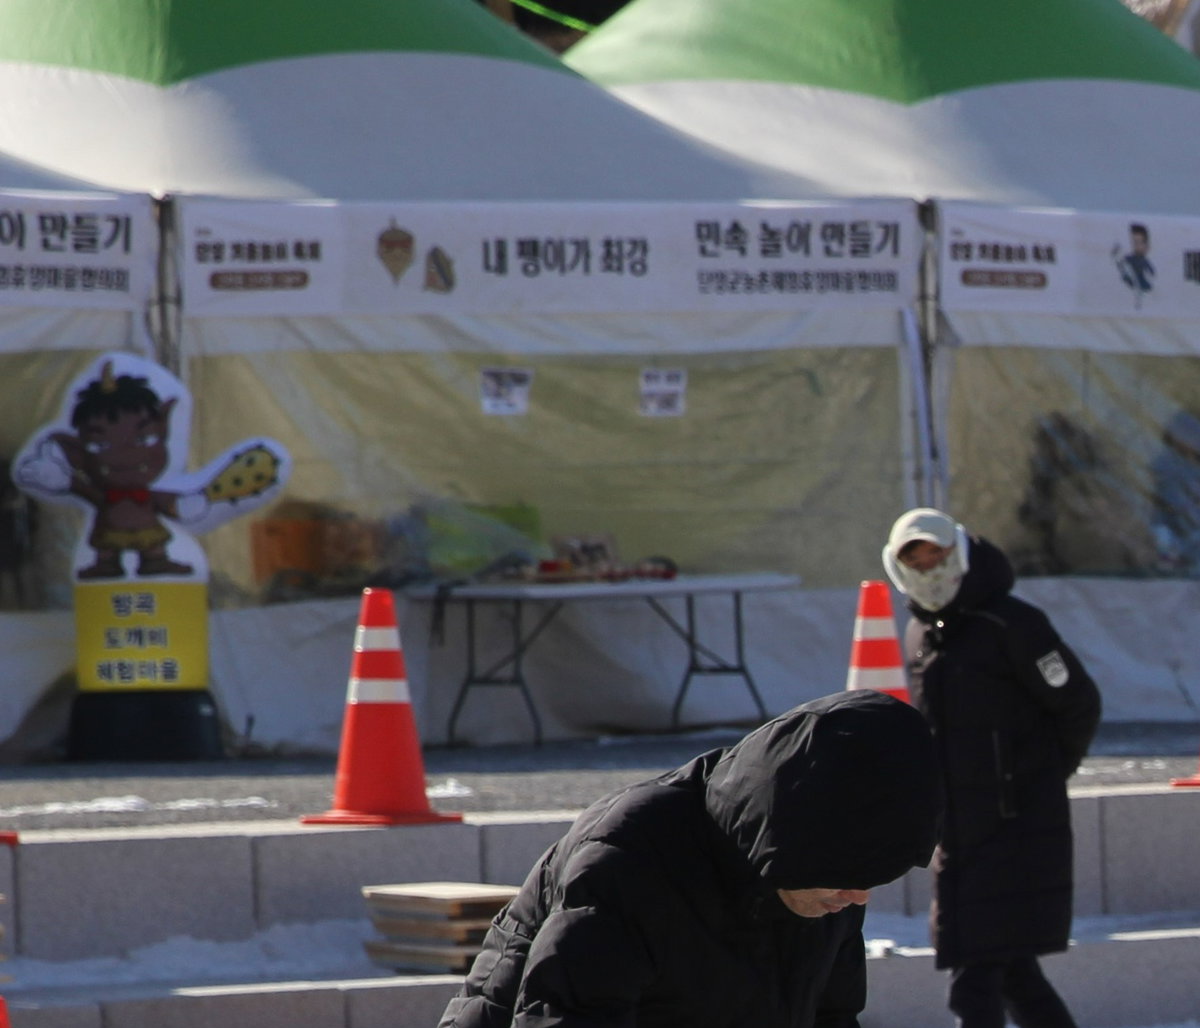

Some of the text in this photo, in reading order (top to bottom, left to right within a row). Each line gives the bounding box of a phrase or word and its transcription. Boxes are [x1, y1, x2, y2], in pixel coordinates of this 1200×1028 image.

[38, 213, 131, 253] 만들기
[695, 219, 902, 258] 민속 놀이 만들기
[481, 238, 649, 277] 내 팽이가 최강
[104, 626, 168, 650] 도깨비
[97, 658, 180, 683] 체험마을
